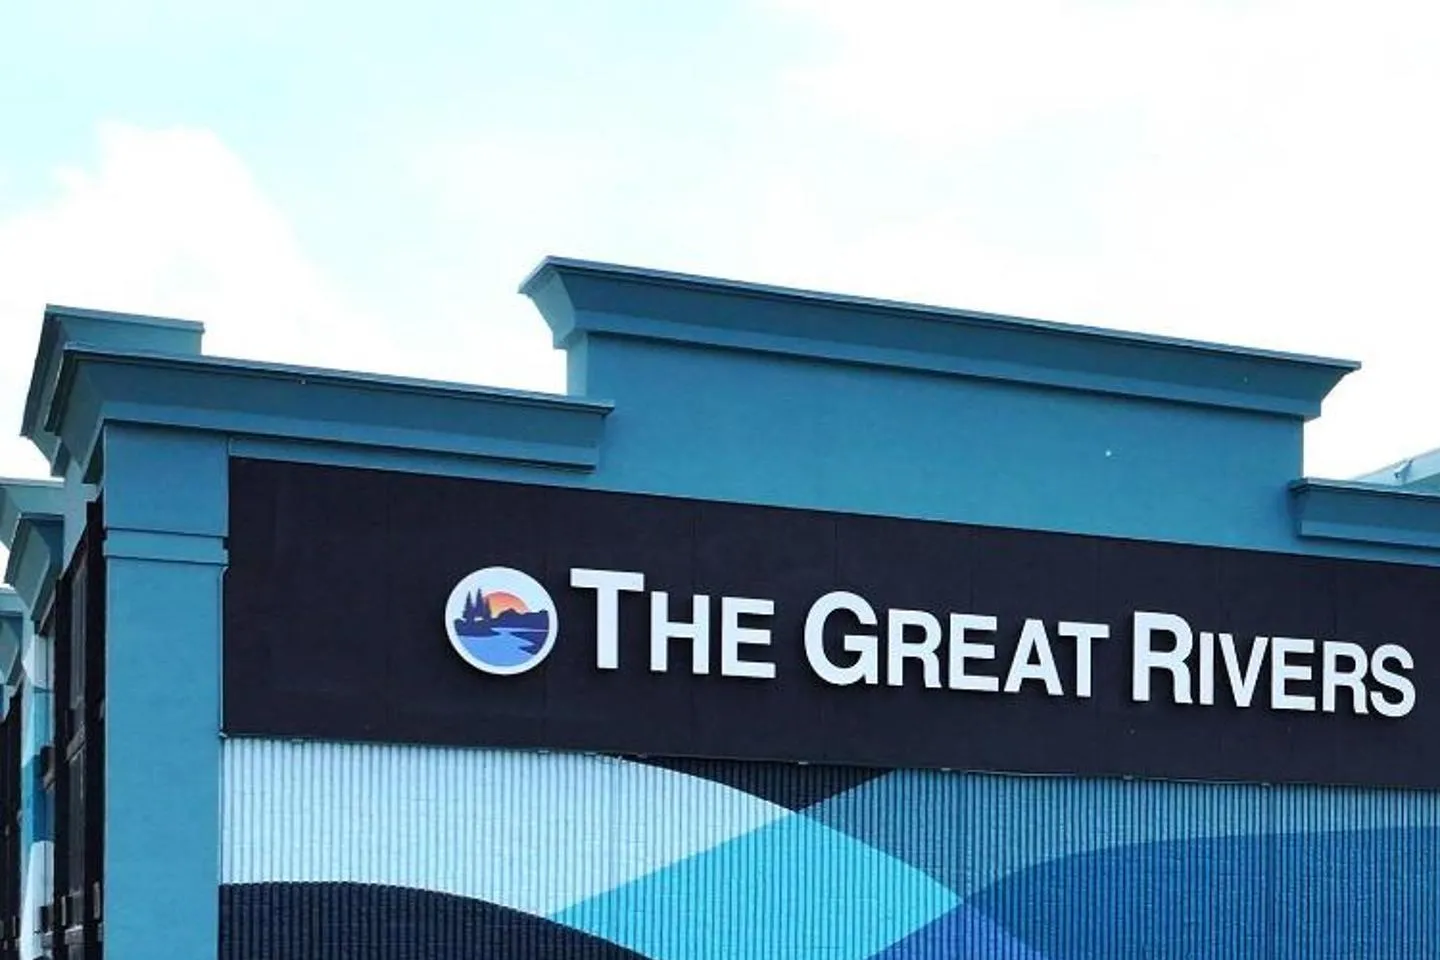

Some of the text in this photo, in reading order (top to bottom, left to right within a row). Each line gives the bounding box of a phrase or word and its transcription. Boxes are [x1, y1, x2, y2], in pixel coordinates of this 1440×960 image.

[570, 567, 1416, 717] THE GREAT RIVERS
